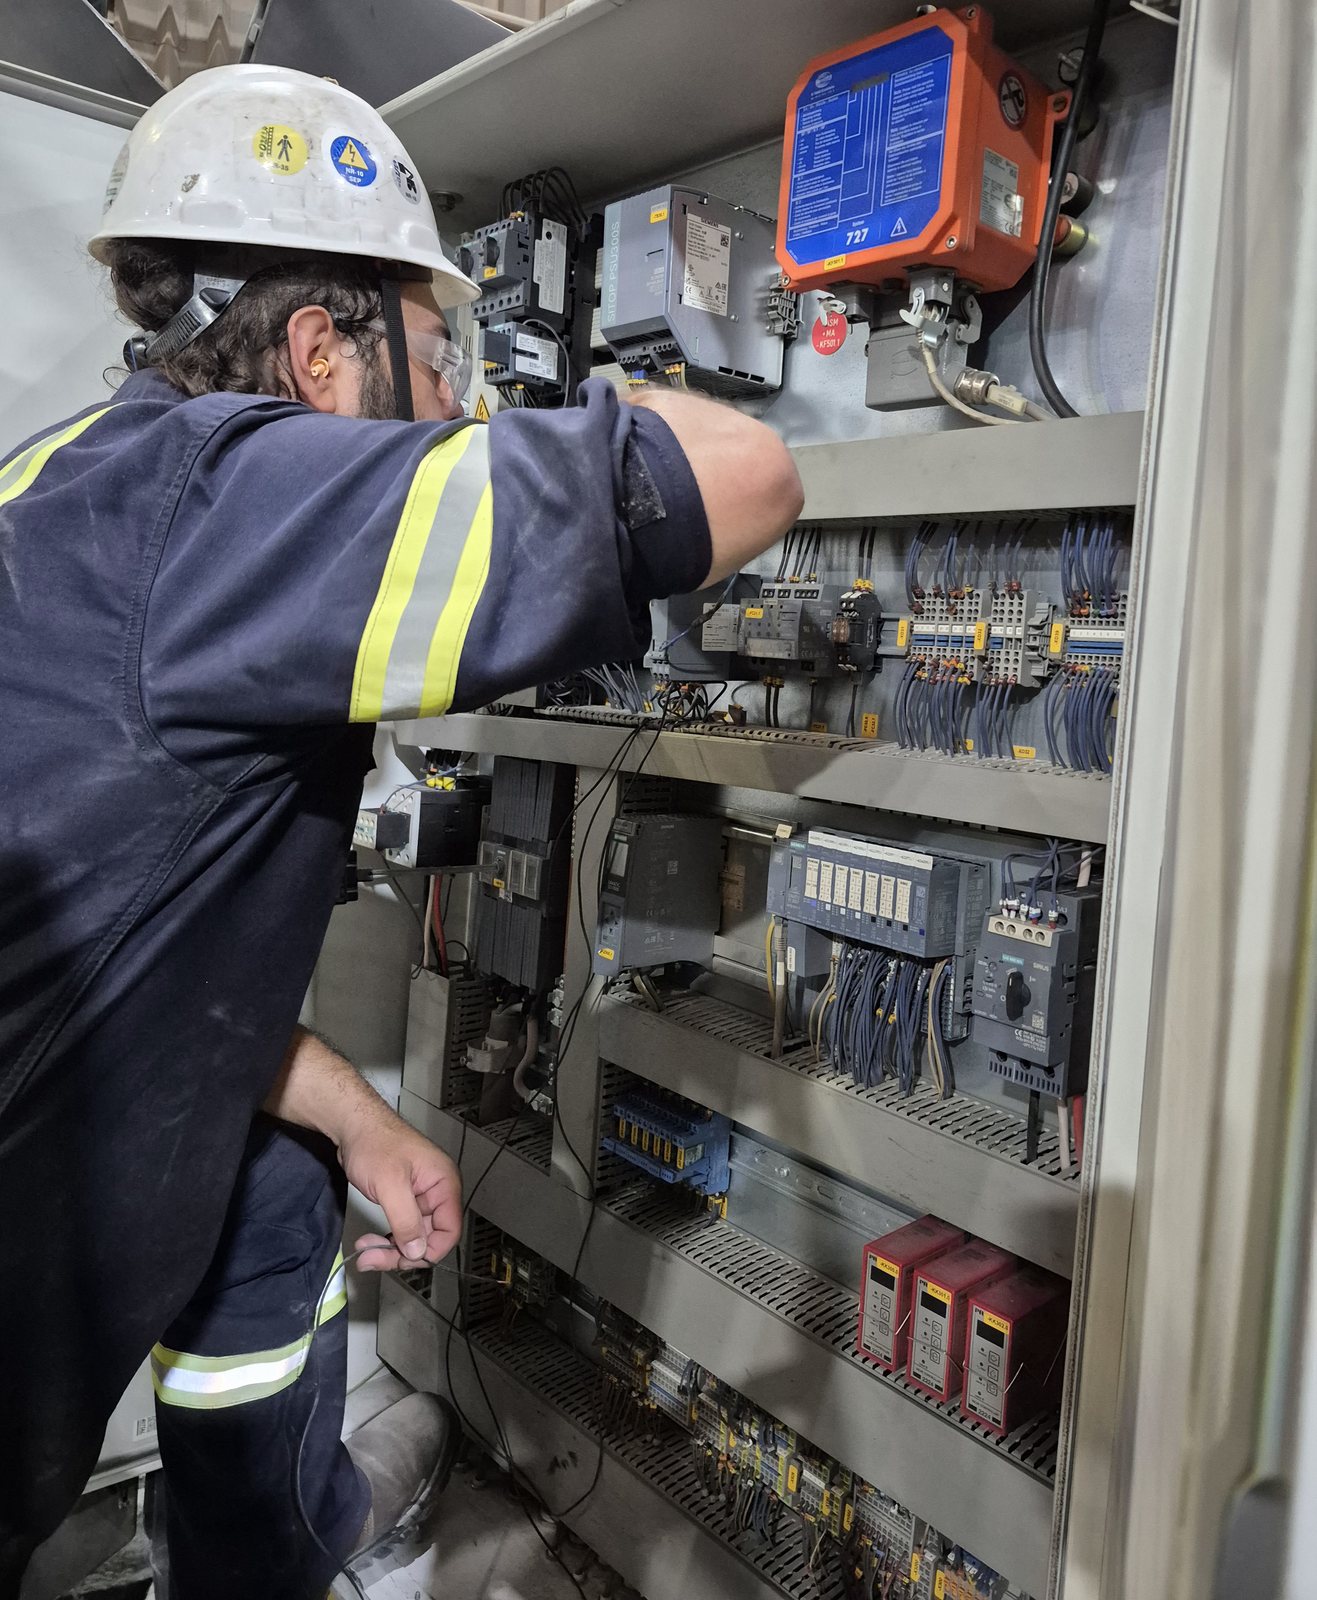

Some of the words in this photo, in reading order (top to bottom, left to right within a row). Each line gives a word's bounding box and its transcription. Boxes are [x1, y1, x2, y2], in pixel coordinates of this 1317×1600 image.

[345, 167, 364, 177] NR-10
[349, 176, 362, 184] SEP
[846, 228, 869, 246] 727
[610, 222, 620, 281] PSU300S
[608, 284, 617, 321] SITOP
[871, 1348, 883, 1358] 2224
[922, 1376, 934, 1388] 2224
[978, 1408, 991, 1421] 2224
